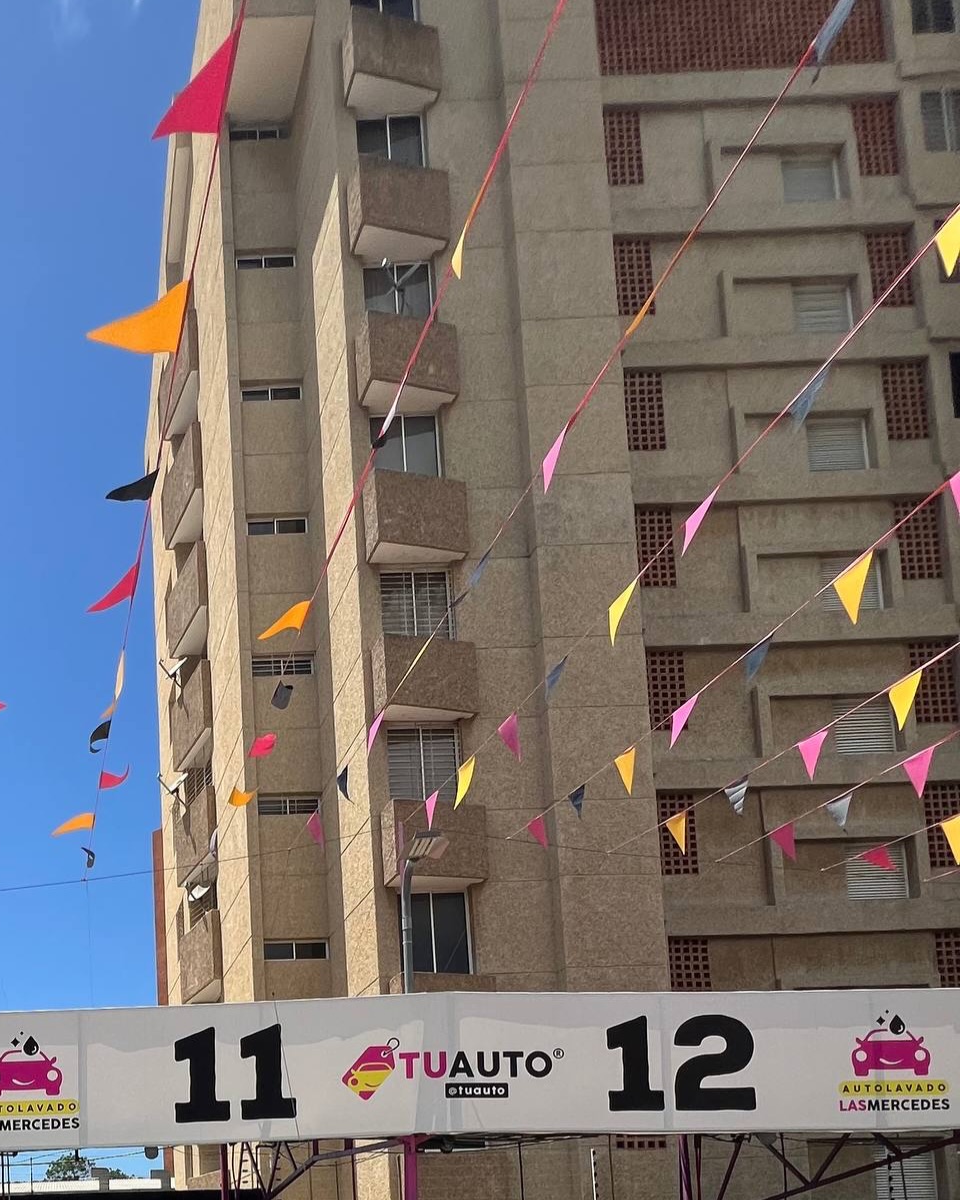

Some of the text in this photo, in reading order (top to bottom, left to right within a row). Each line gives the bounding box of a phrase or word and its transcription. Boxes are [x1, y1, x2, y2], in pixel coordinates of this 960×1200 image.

[173, 1022, 297, 1124] 11
[606, 1014, 758, 1112] 12
[842, 1083, 947, 1094] AUTOLAVADO
